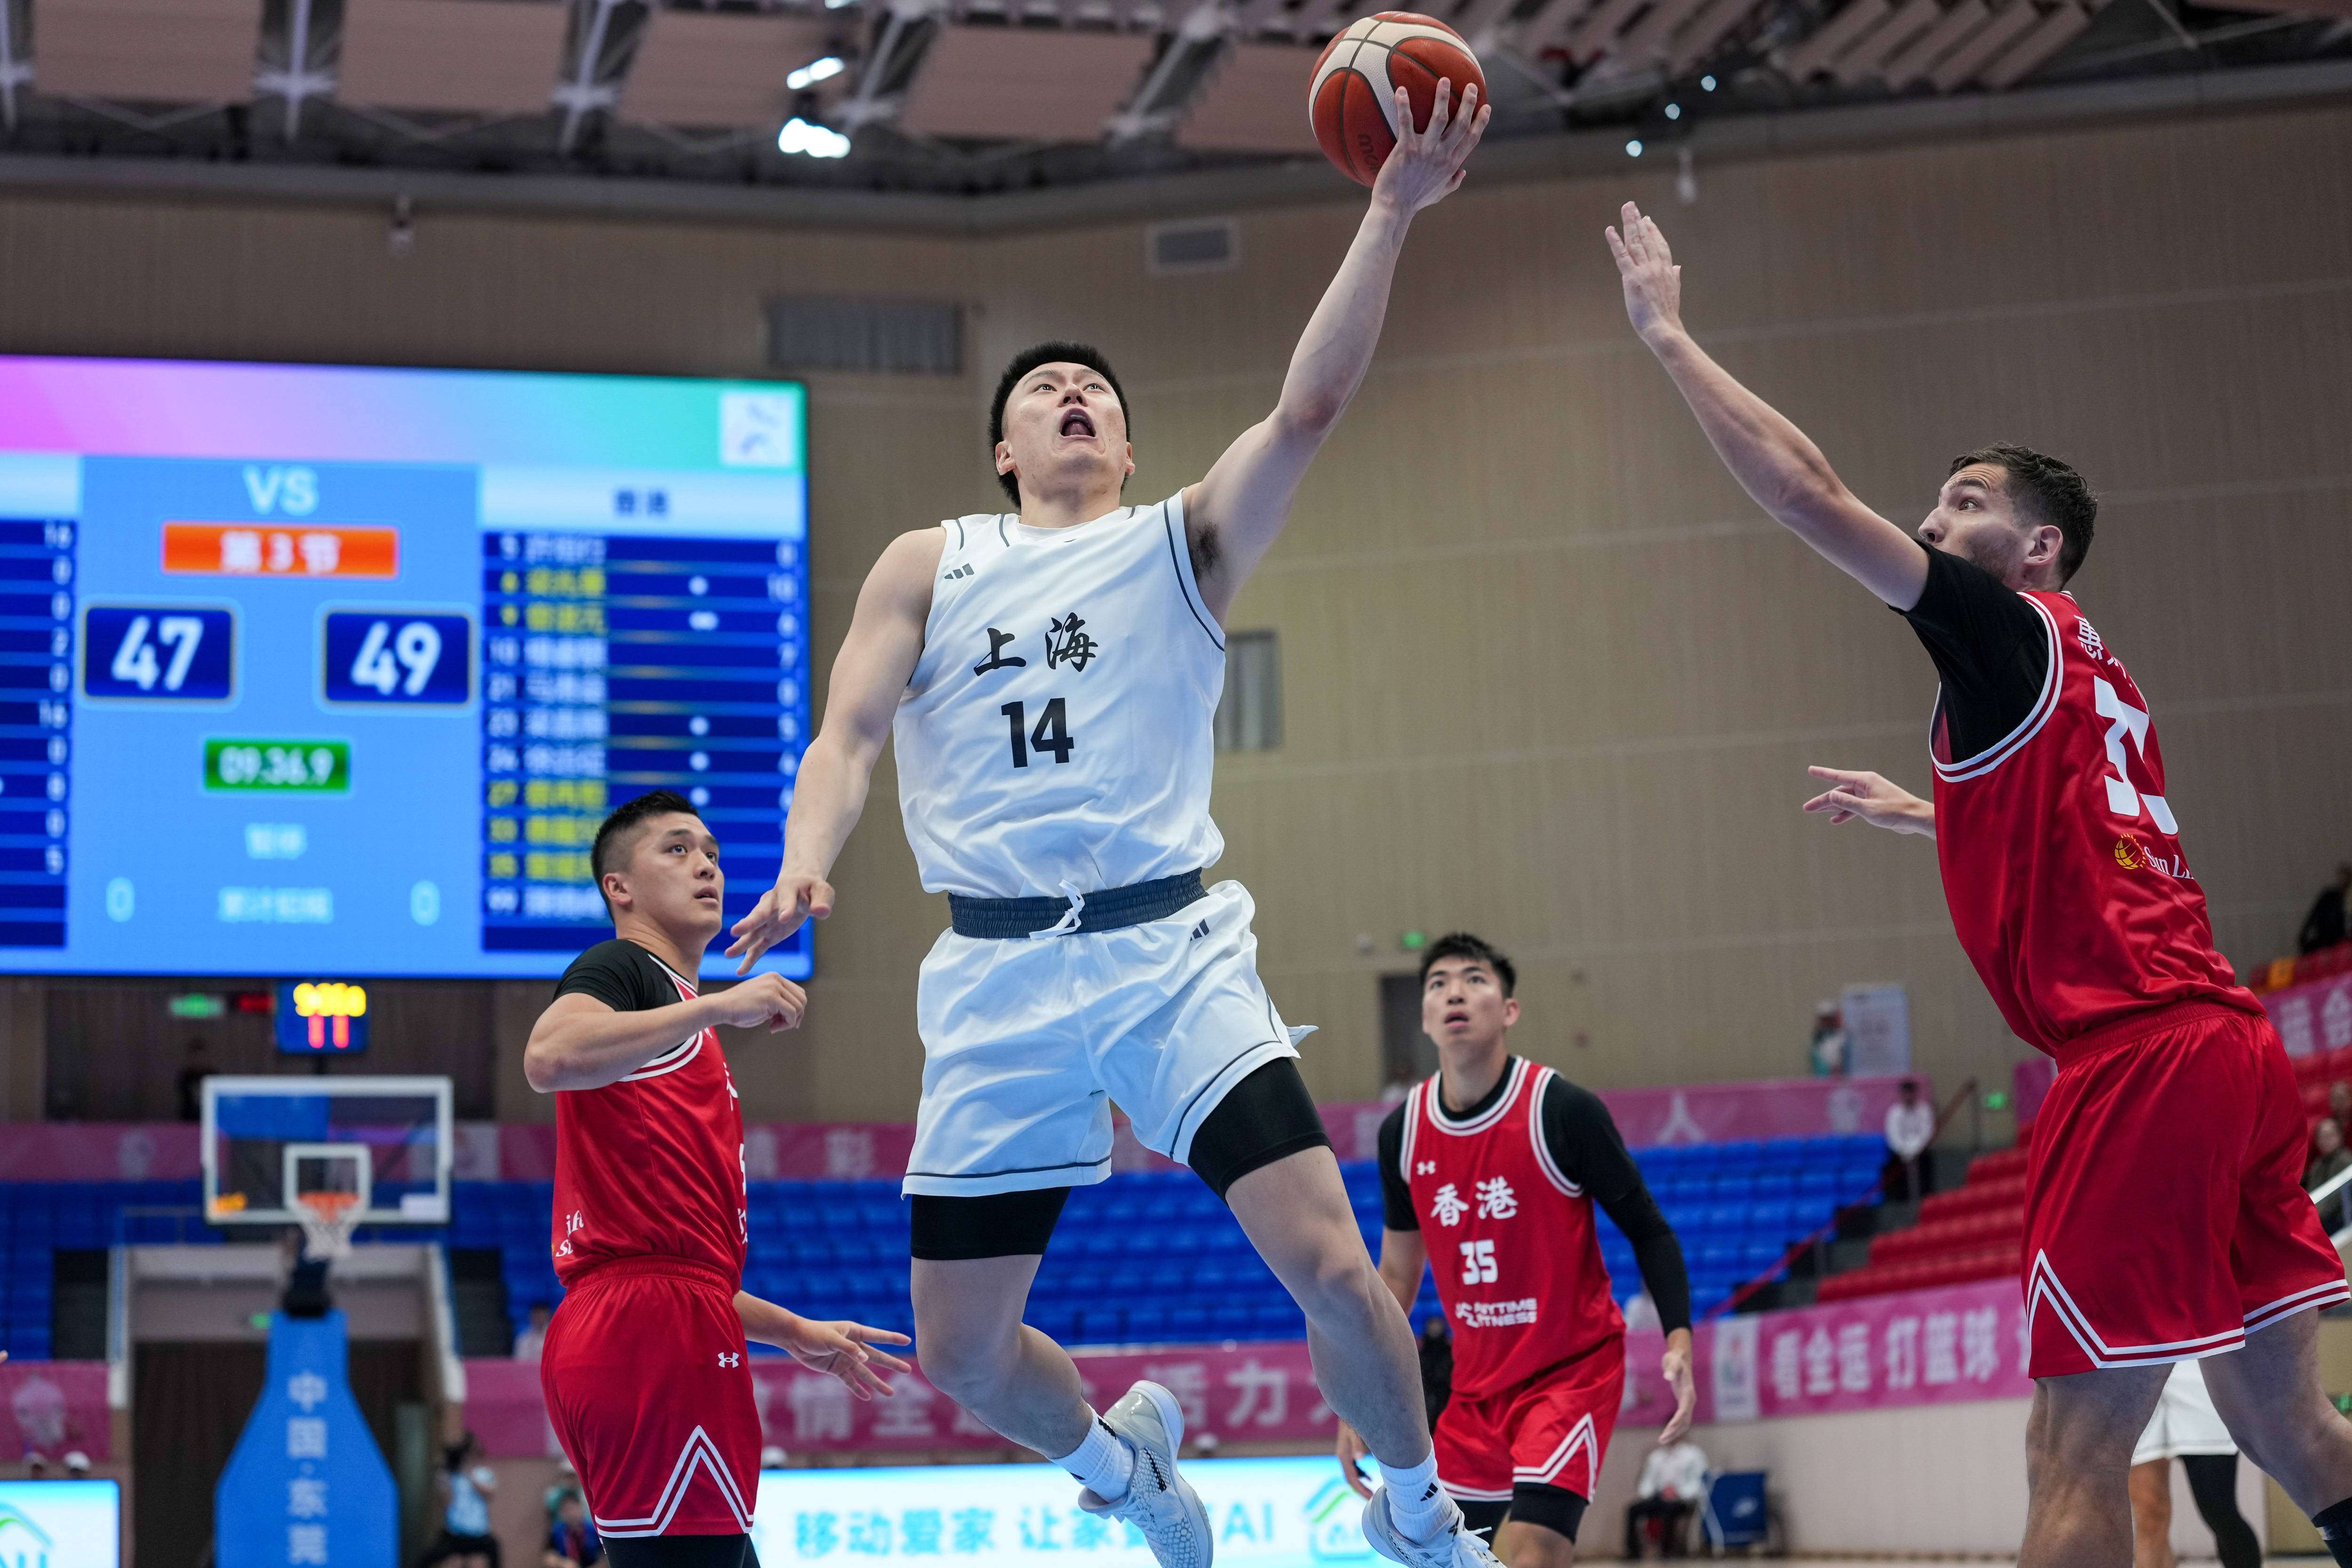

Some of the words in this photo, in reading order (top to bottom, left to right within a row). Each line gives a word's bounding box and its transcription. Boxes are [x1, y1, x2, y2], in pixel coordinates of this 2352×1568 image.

[243, 465, 319, 515] VS
[110, 615, 204, 690] 47
[350, 621, 442, 695] 49
[974, 612, 1098, 677] 上海
[1001, 697, 1074, 768] 14
[2144, 846, 2170, 876] Sun
[106, 877, 135, 923] 0
[410, 880, 440, 926] 0
[1430, 1176, 1518, 1226] 香港
[1459, 1240, 1498, 1285] 35
[1886, 1305, 1999, 1389] 打篮球
